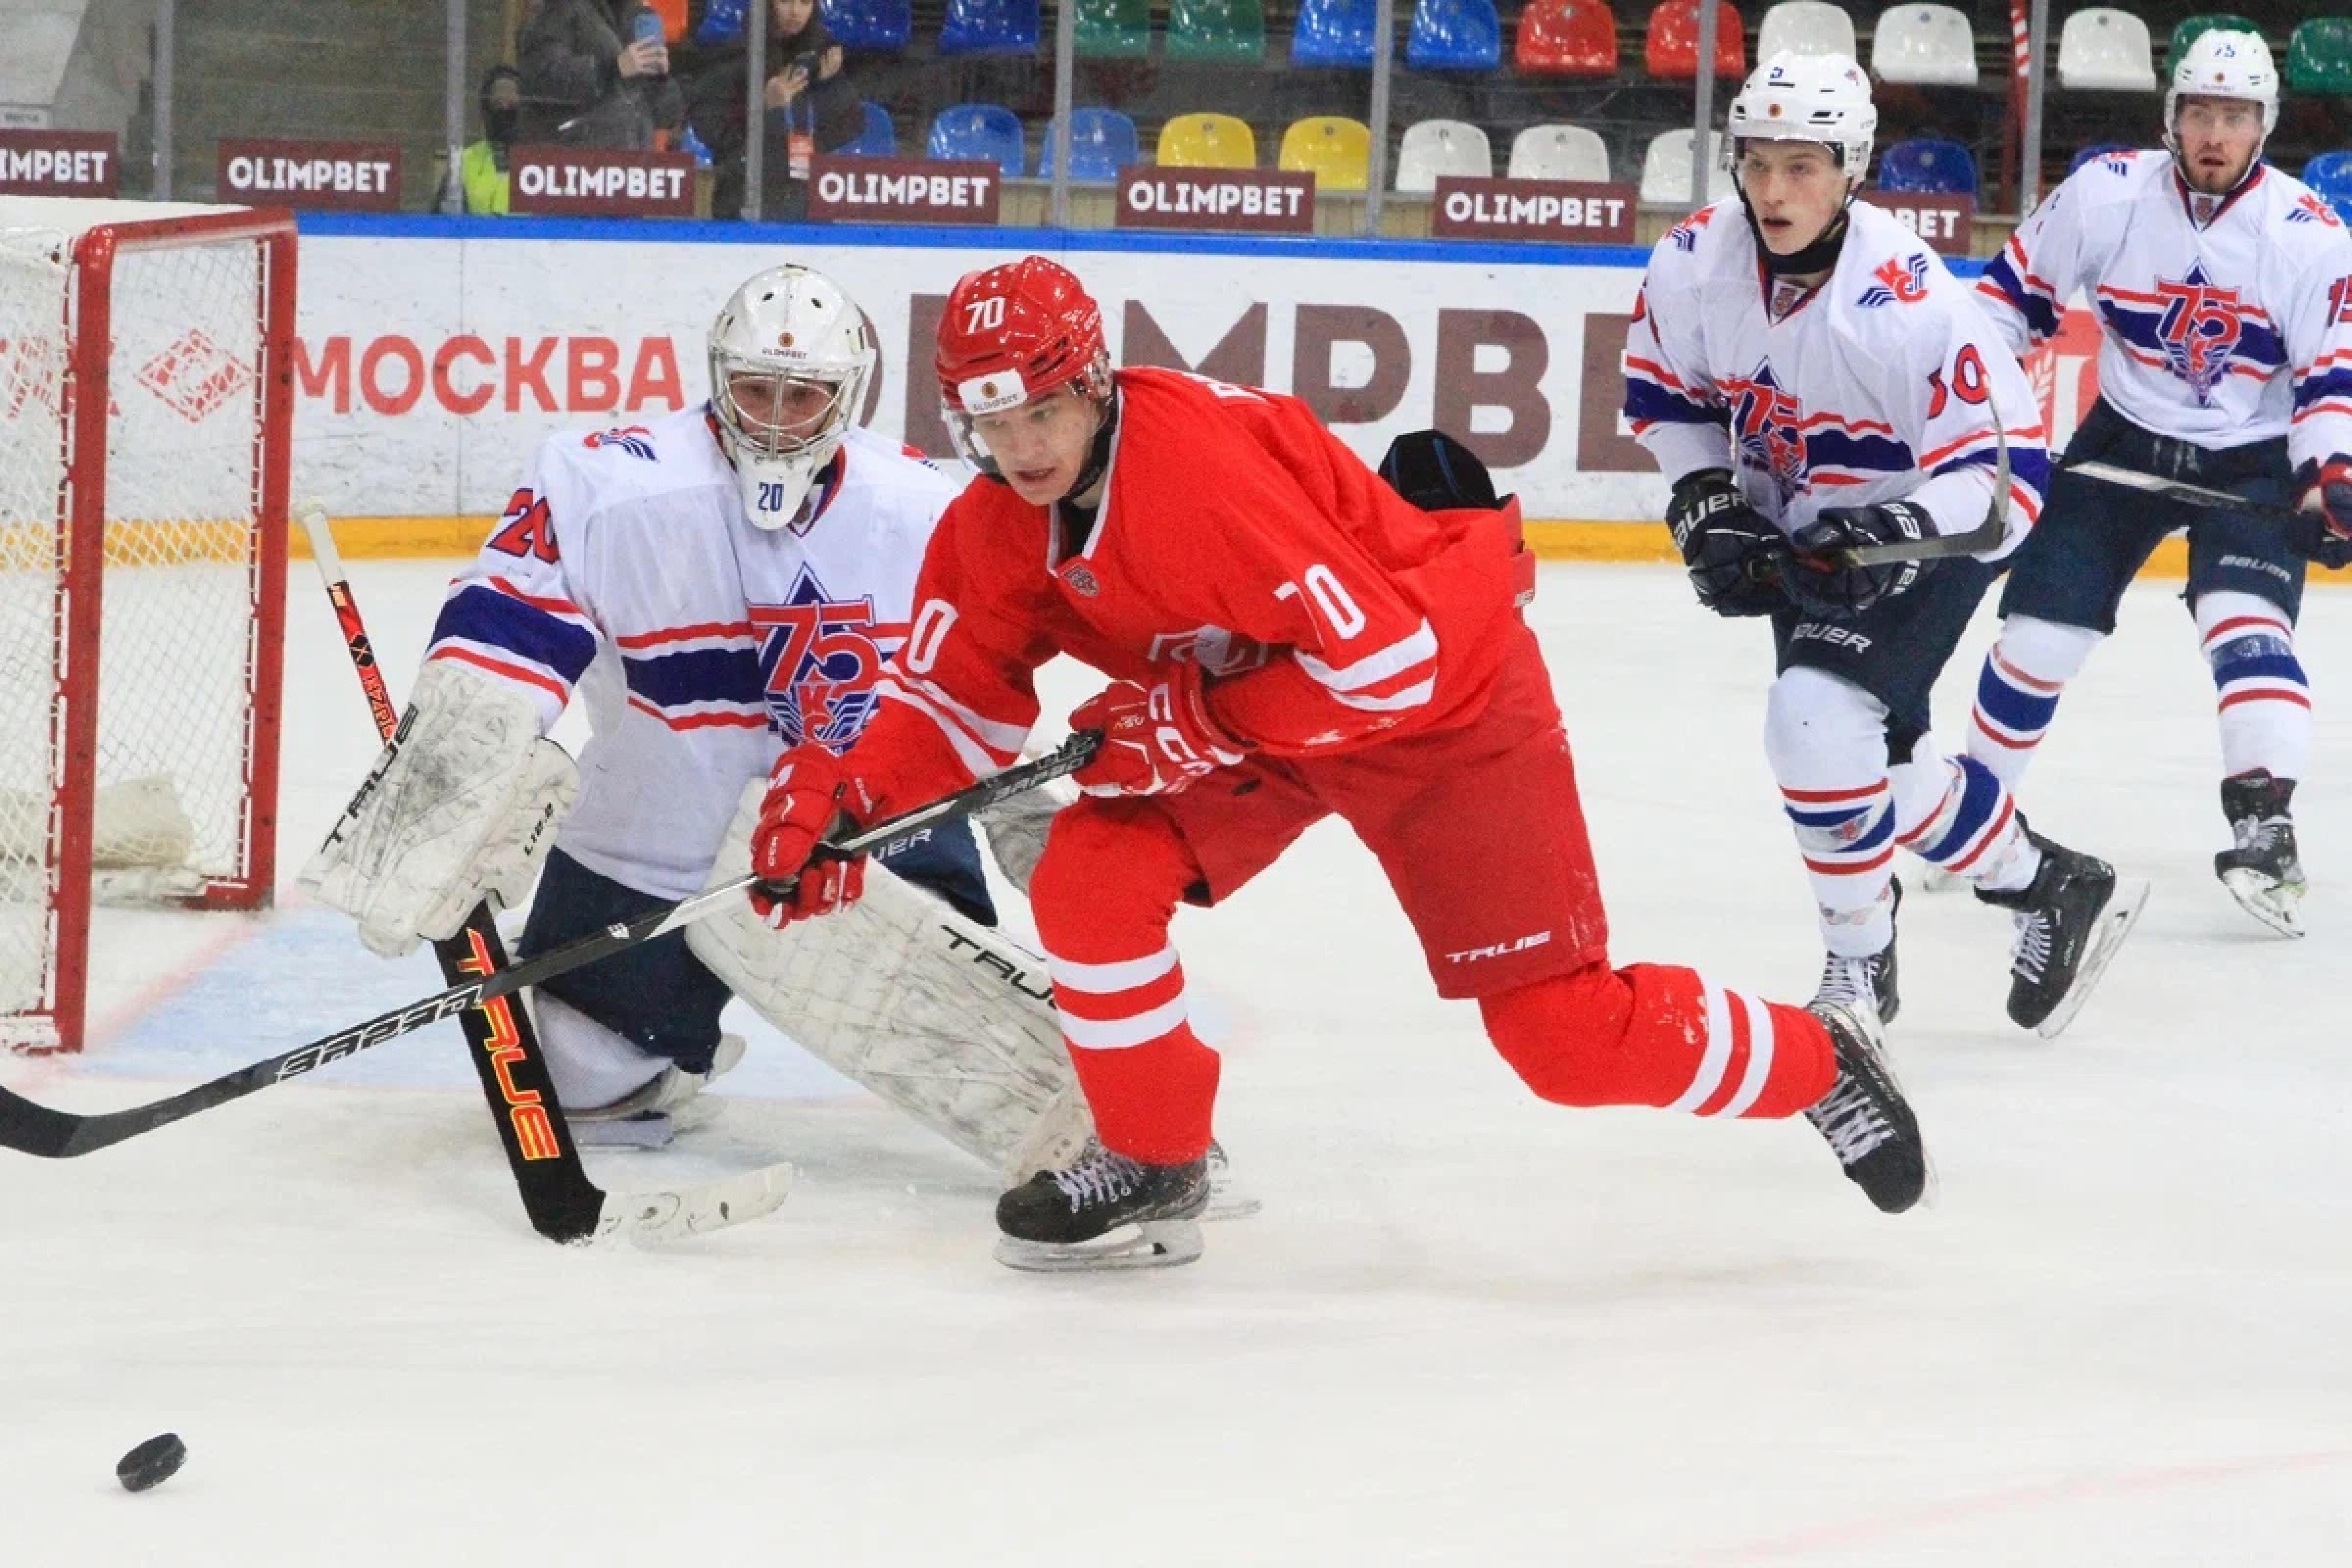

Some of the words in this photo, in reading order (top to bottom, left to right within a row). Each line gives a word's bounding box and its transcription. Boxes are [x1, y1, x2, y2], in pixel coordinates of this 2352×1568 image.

[227, 156, 391, 193] OLIMPBET
[519, 164, 686, 198] OLIMPBET
[818, 172, 990, 206] OLIMPBET
[1128, 180, 1304, 216] OLIMPBET
[1445, 192, 1625, 228] OLIMPBET
[1896, 208, 1960, 240] BET
[965, 295, 1005, 336] 70
[2156, 275, 2242, 350] 75
[294, 334, 685, 416] МОСКВА
[758, 482, 783, 512] 20
[487, 487, 561, 564] 20
[746, 593, 883, 700] 75
[321, 702, 419, 853] TRUE
[1445, 930, 1552, 964] TRUE
[940, 925, 1057, 1010] TRU
[457, 928, 561, 1161] TRUE
